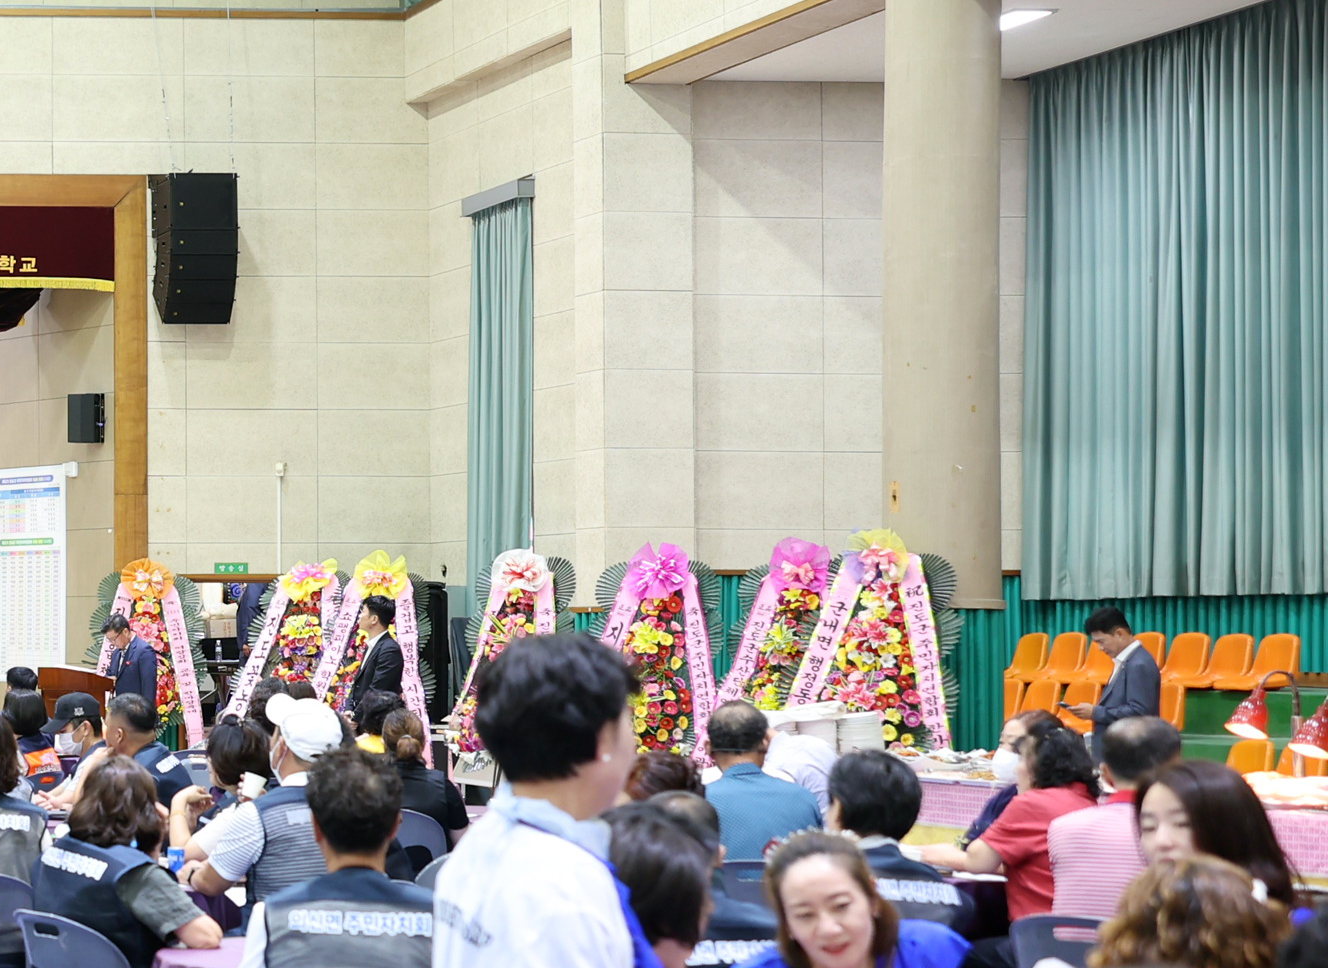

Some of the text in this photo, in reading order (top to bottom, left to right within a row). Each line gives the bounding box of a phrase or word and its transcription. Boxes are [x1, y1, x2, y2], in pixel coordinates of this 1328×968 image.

[817, 601, 848, 651] 군내면
[910, 600, 928, 635] 진도군
[343, 910, 433, 937] 주민자치회
